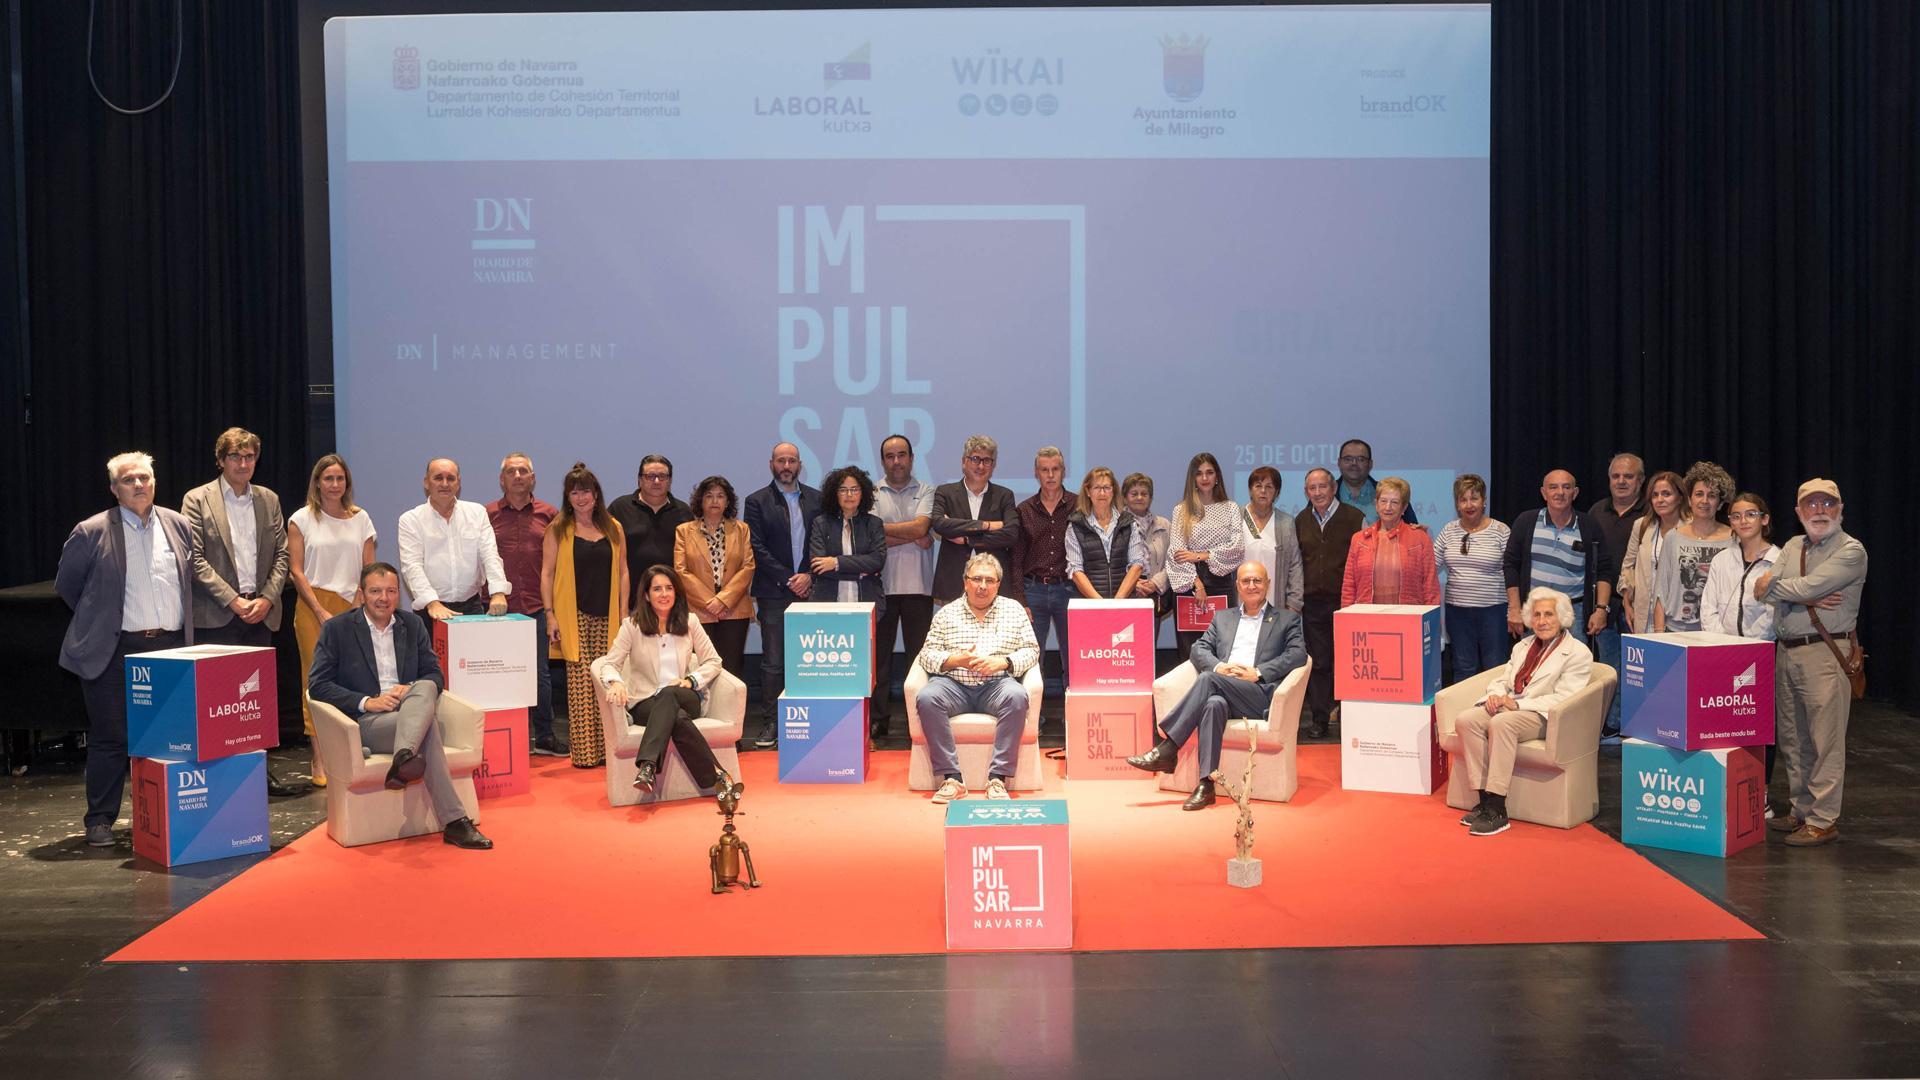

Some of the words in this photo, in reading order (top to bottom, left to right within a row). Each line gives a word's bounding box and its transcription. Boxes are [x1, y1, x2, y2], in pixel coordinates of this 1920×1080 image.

[426, 59, 494, 72] Gobierno
[497, 59, 516, 72] de
[521, 59, 578, 72] Navarra
[950, 48, 1065, 86] WÏKAI
[426, 75, 508, 87] Nafarroako
[512, 74, 585, 87] Gobernua
[426, 90, 524, 104] Departamento
[527, 90, 546, 102] de
[617, 88, 680, 102] Territorial
[1360, 95, 1447, 113] brandOK
[426, 105, 482, 118] Lurralde
[487, 105, 572, 118] Kohesiorako
[576, 104, 680, 119] Departamentua
[754, 96, 871, 116] LABORAL
[1133, 106, 1237, 122] Ayuntamiento
[823, 119, 871, 133] kutxa
[1145, 122, 1164, 136] de
[1168, 122, 1225, 139] Milagro
[472, 197, 534, 232] DN
[777, 205, 865, 294] IM
[473, 257, 514, 269] DIARIO
[516, 257, 533, 269] DE
[473, 270, 535, 283] NAVARRA
[396, 344, 423, 360] DN
[452, 343, 617, 360] MANAGEMENT
[778, 306, 932, 396] PUL
[778, 405, 936, 488] SAR
[1234, 445, 1256, 465] 25
[1262, 444, 1284, 465] DE
[1291, 444, 1340, 465] OCTU
[799, 629, 854, 648] WÏKAI
[1352, 632, 1367, 647] IM
[1080, 649, 1135, 659] LABORAL
[1352, 648, 1378, 663] PUL
[1626, 646, 1645, 664] DN
[132, 666, 151, 682] DN
[1352, 664, 1379, 680] SAR
[209, 699, 260, 718] LABORAL
[1700, 694, 1756, 708] LABORAL
[240, 712, 261, 721] kutxa
[786, 706, 809, 720] DN
[1086, 712, 1102, 727] IM
[1733, 707, 1756, 716] kutxa
[1087, 728, 1112, 744] PUL
[1087, 745, 1114, 760] SAR
[178, 769, 207, 788] DN
[472, 763, 490, 778] AR
[828, 768, 855, 776] brandOK
[1638, 768, 1704, 795] WÏKAI
[178, 802, 208, 811] NAVARRA
[231, 835, 263, 846] brandOK
[972, 846, 993, 867] IM
[973, 868, 1008, 890] PUL
[974, 890, 1010, 912] SAR
[974, 918, 1043, 929] NAVARRA
